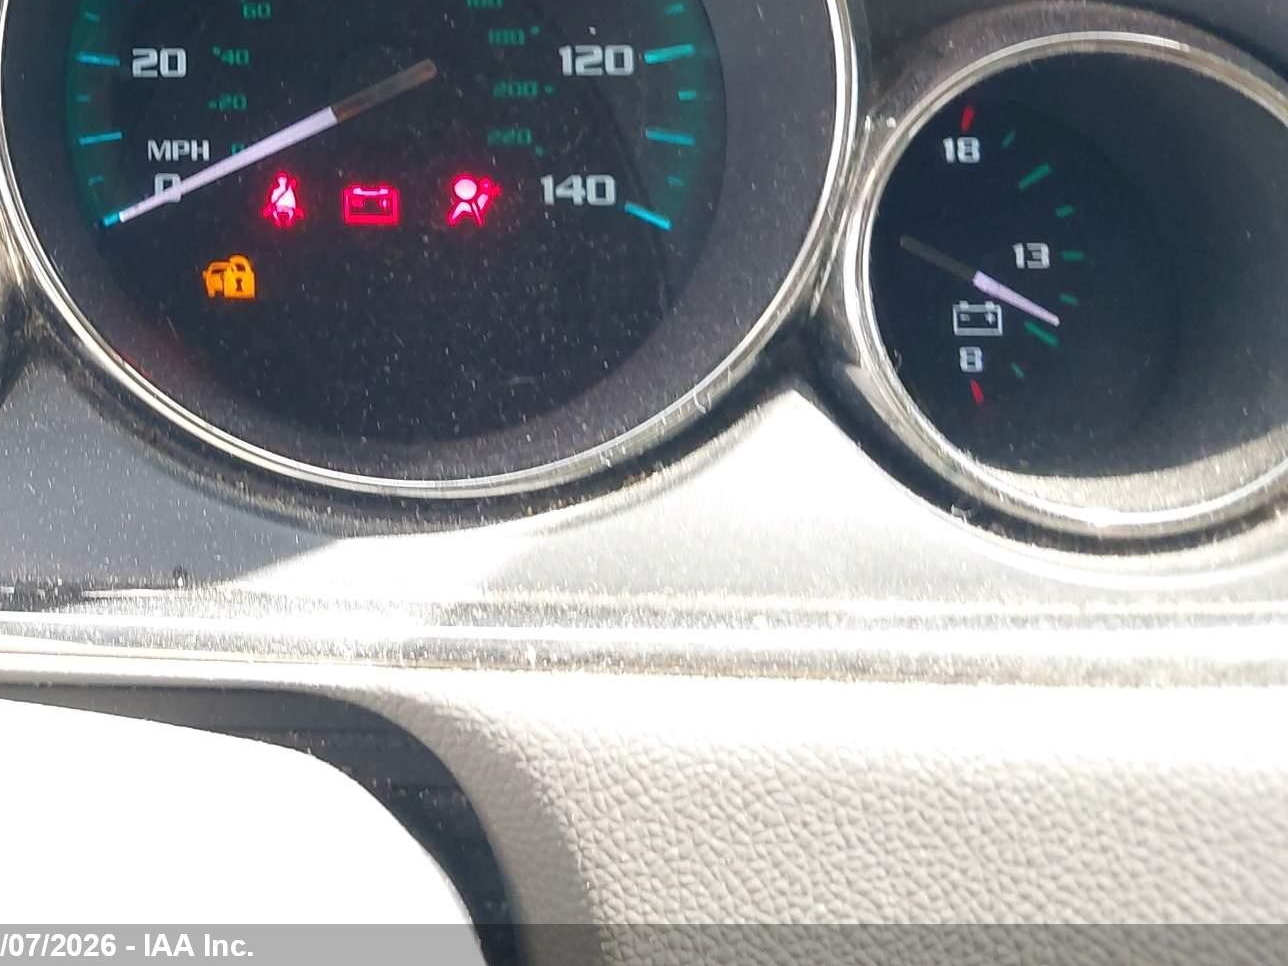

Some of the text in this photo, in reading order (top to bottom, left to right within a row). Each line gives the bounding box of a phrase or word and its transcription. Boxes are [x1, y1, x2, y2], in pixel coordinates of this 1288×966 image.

[242, 1, 271, 19] 60
[131, 48, 187, 79] 20
[221, 48, 250, 66] 40
[559, 45, 635, 76] 120
[219, 93, 247, 110] 20
[493, 81, 538, 98] 200
[147, 139, 210, 162] MPH
[943, 137, 980, 163] 18
[154, 173, 182, 203] 0
[540, 175, 615, 205] 140
[1013, 242, 1050, 269] 13
[959, 346, 983, 372] 8
